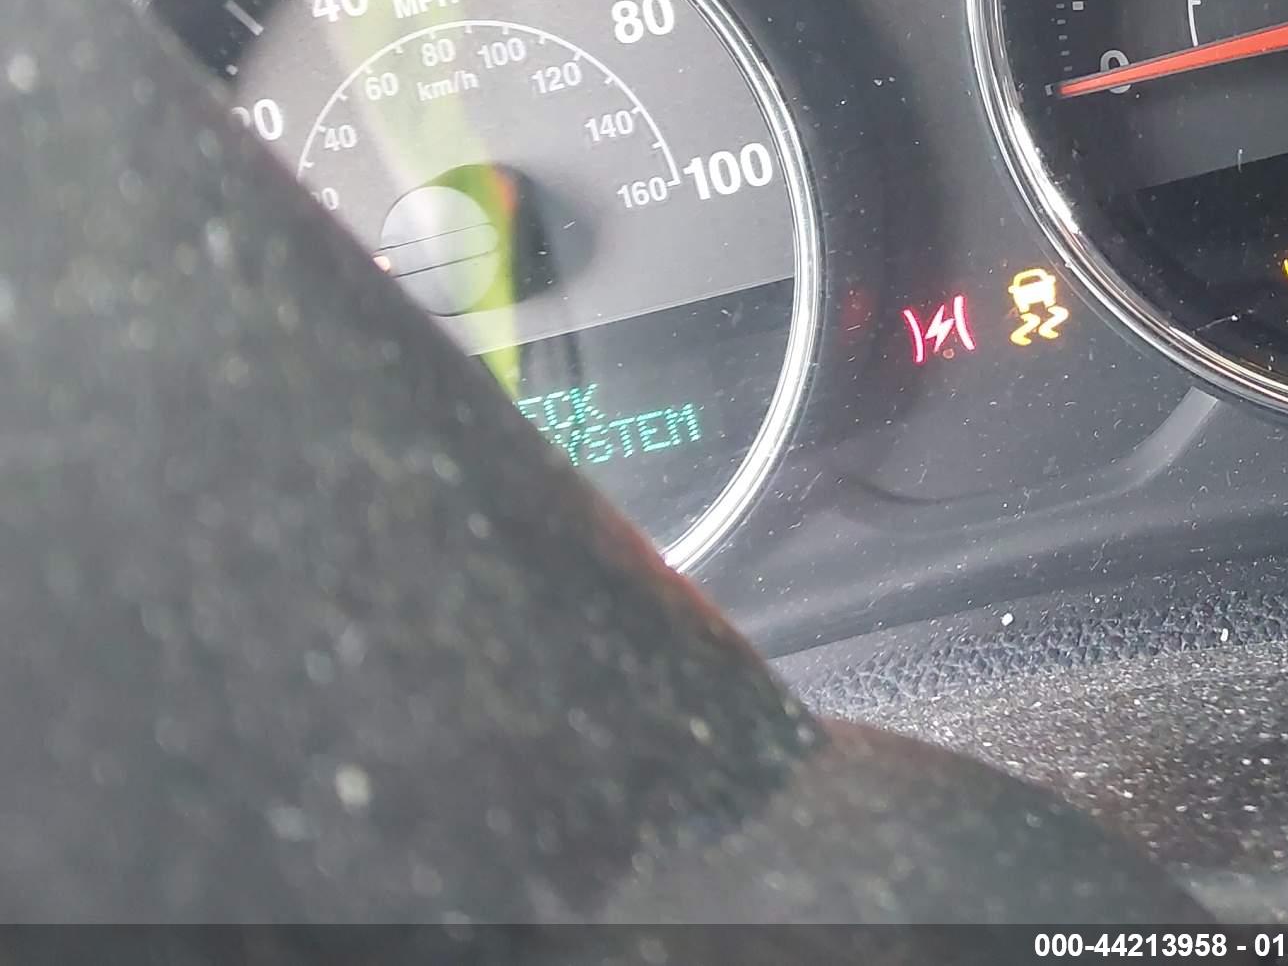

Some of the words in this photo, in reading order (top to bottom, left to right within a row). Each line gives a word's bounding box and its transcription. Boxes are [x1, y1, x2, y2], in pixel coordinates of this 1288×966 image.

[421, 38, 455, 67] 80
[477, 37, 526, 69] 100
[364, 72, 399, 101] 60
[416, 70, 479, 101] km/h
[532, 62, 582, 94] 120
[323, 124, 357, 152] 40
[584, 109, 634, 143] 140
[683, 142, 774, 201] 100
[311, 187, 339, 211] 0
[617, 176, 668, 208] 160
[550, 403, 701, 466] YSTEM
